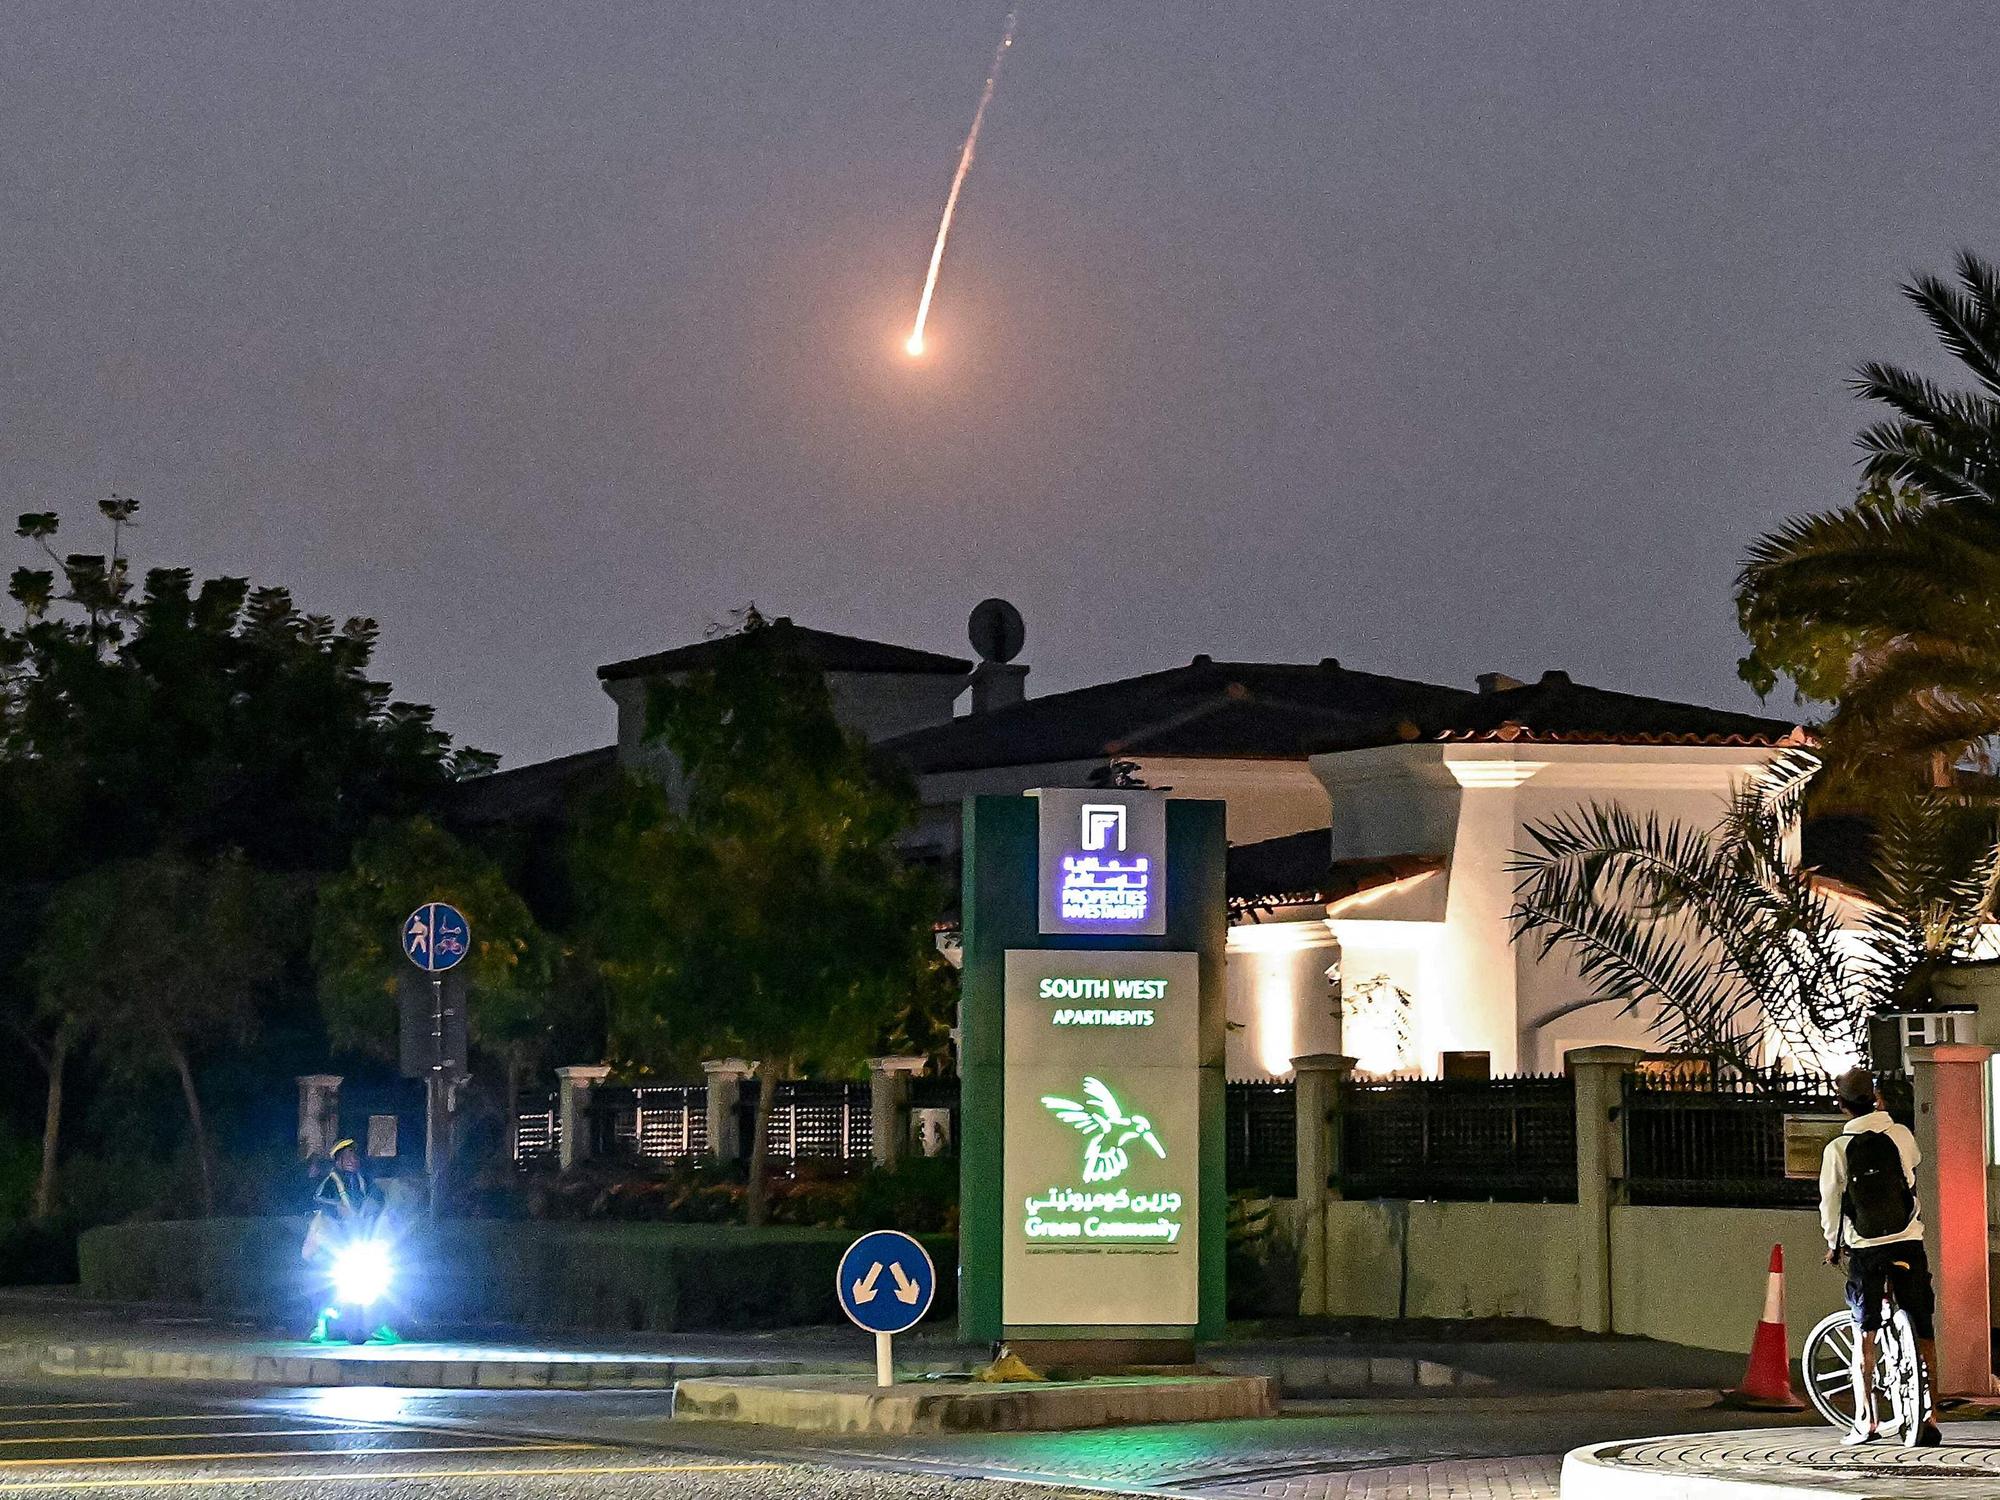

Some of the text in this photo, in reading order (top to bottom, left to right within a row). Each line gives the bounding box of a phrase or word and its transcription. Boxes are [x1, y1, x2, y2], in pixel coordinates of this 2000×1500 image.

[1039, 978, 1168, 1000] SOUTH WEST
[1052, 1009, 1155, 1026] APARTMENTS
[1024, 1187, 1182, 1216] جرين كوميونيتي
[1024, 1216, 1182, 1242] Green Community
